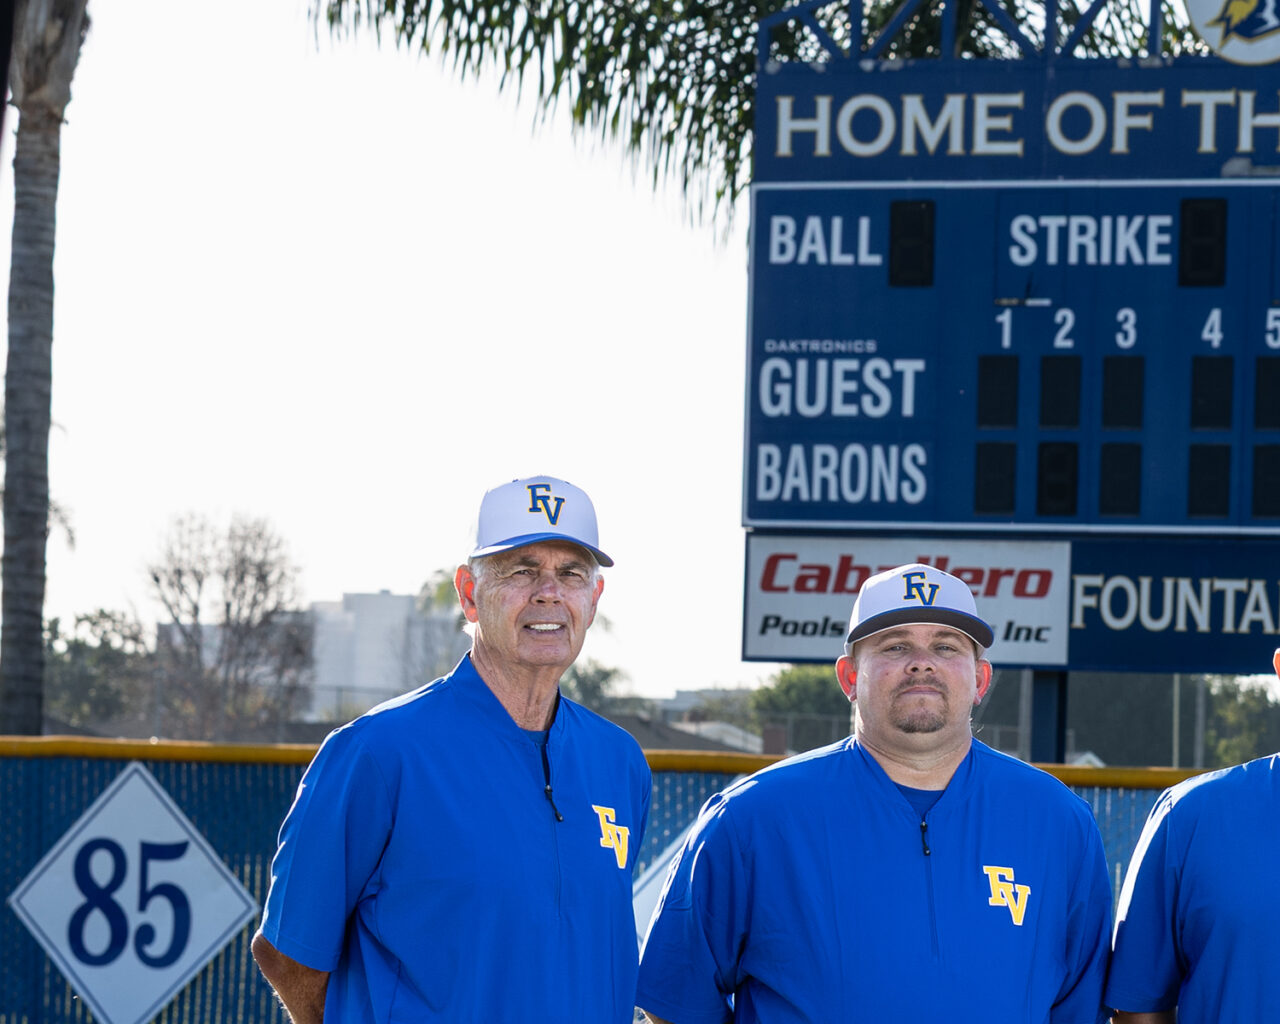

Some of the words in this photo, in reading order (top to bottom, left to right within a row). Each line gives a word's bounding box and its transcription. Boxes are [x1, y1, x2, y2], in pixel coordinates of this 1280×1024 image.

[775, 92, 1024, 157] HOME
[1045, 90, 1164, 155] OF
[769, 215, 882, 266] BALL
[1009, 214, 1173, 267] STRIKE
[764, 339, 877, 353] DAKTRONICS
[995, 307, 1012, 349] 1
[1053, 307, 1075, 349] 2
[1115, 307, 1137, 349] 3
[1201, 307, 1223, 349] 4
[759, 357, 926, 418] GUEST
[756, 443, 928, 504] BARONS
[527, 483, 565, 526] FV
[760, 553, 1053, 599] Cabero
[902, 571, 941, 605] FV
[759, 614, 846, 638] Pools
[1002, 620, 1052, 643] Inc
[591, 804, 630, 870] FV
[67, 837, 192, 970] 85
[983, 865, 1031, 927] FV
